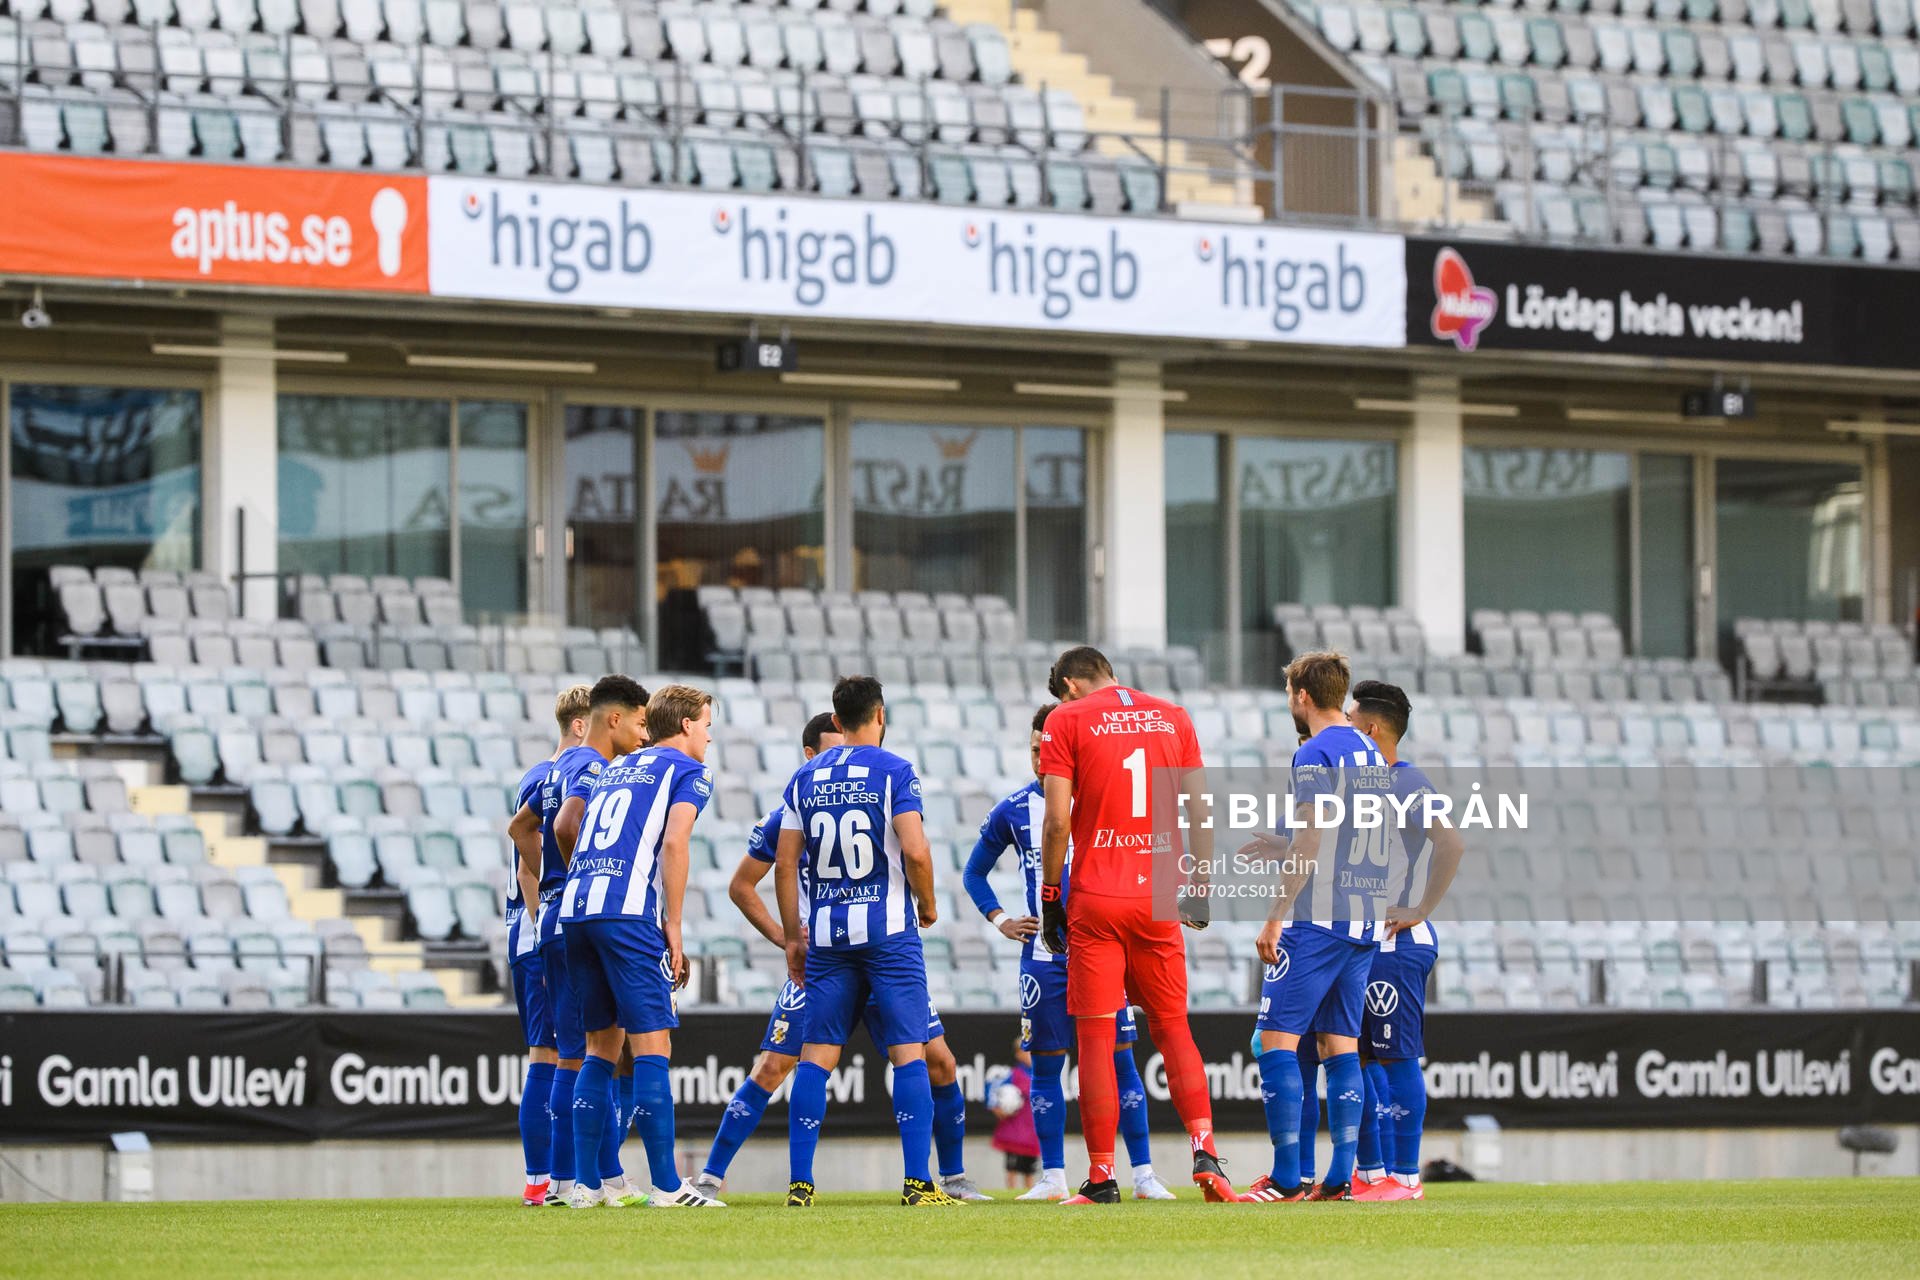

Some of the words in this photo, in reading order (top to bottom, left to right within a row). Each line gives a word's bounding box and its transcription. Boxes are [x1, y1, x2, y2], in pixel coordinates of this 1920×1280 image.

[171, 201, 352, 273] aptus.se
[489, 191, 653, 294] higab
[741, 206, 896, 306] higab
[988, 221, 1138, 319] higab
[1222, 235, 1364, 332] higab
[1506, 284, 1614, 342] Lördag
[1620, 291, 1684, 336] hela
[1688, 298, 1803, 343] veckan!
[1090, 721, 1175, 736] WELLNESS
[1103, 709, 1162, 722] NORDIC
[603, 766, 648, 778] NORDIC
[813, 781, 866, 796] NORDIC
[1123, 747, 1147, 818] 1
[578, 788, 633, 852] 19
[802, 792, 879, 808] WELLNESS
[810, 810, 874, 880] 26
[1093, 829, 1115, 848] El
[1115, 832, 1172, 847] KONTAKT
[576, 857, 626, 872] KONTAKT
[816, 883, 829, 899] El
[829, 884, 880, 900] KONTAKT
[1384, 1024, 1391, 1039] 8
[38, 1053, 180, 1108] Gamla
[188, 1055, 307, 1108] Ullevi
[330, 1052, 468, 1106] Gamla
[670, 1054, 745, 1105] mla
[1145, 1052, 1262, 1101] Gmla
[1520, 1050, 1619, 1099] Ullevi
[1635, 1050, 1751, 1098] Gamla
[1756, 1049, 1851, 1097] Ullevi
